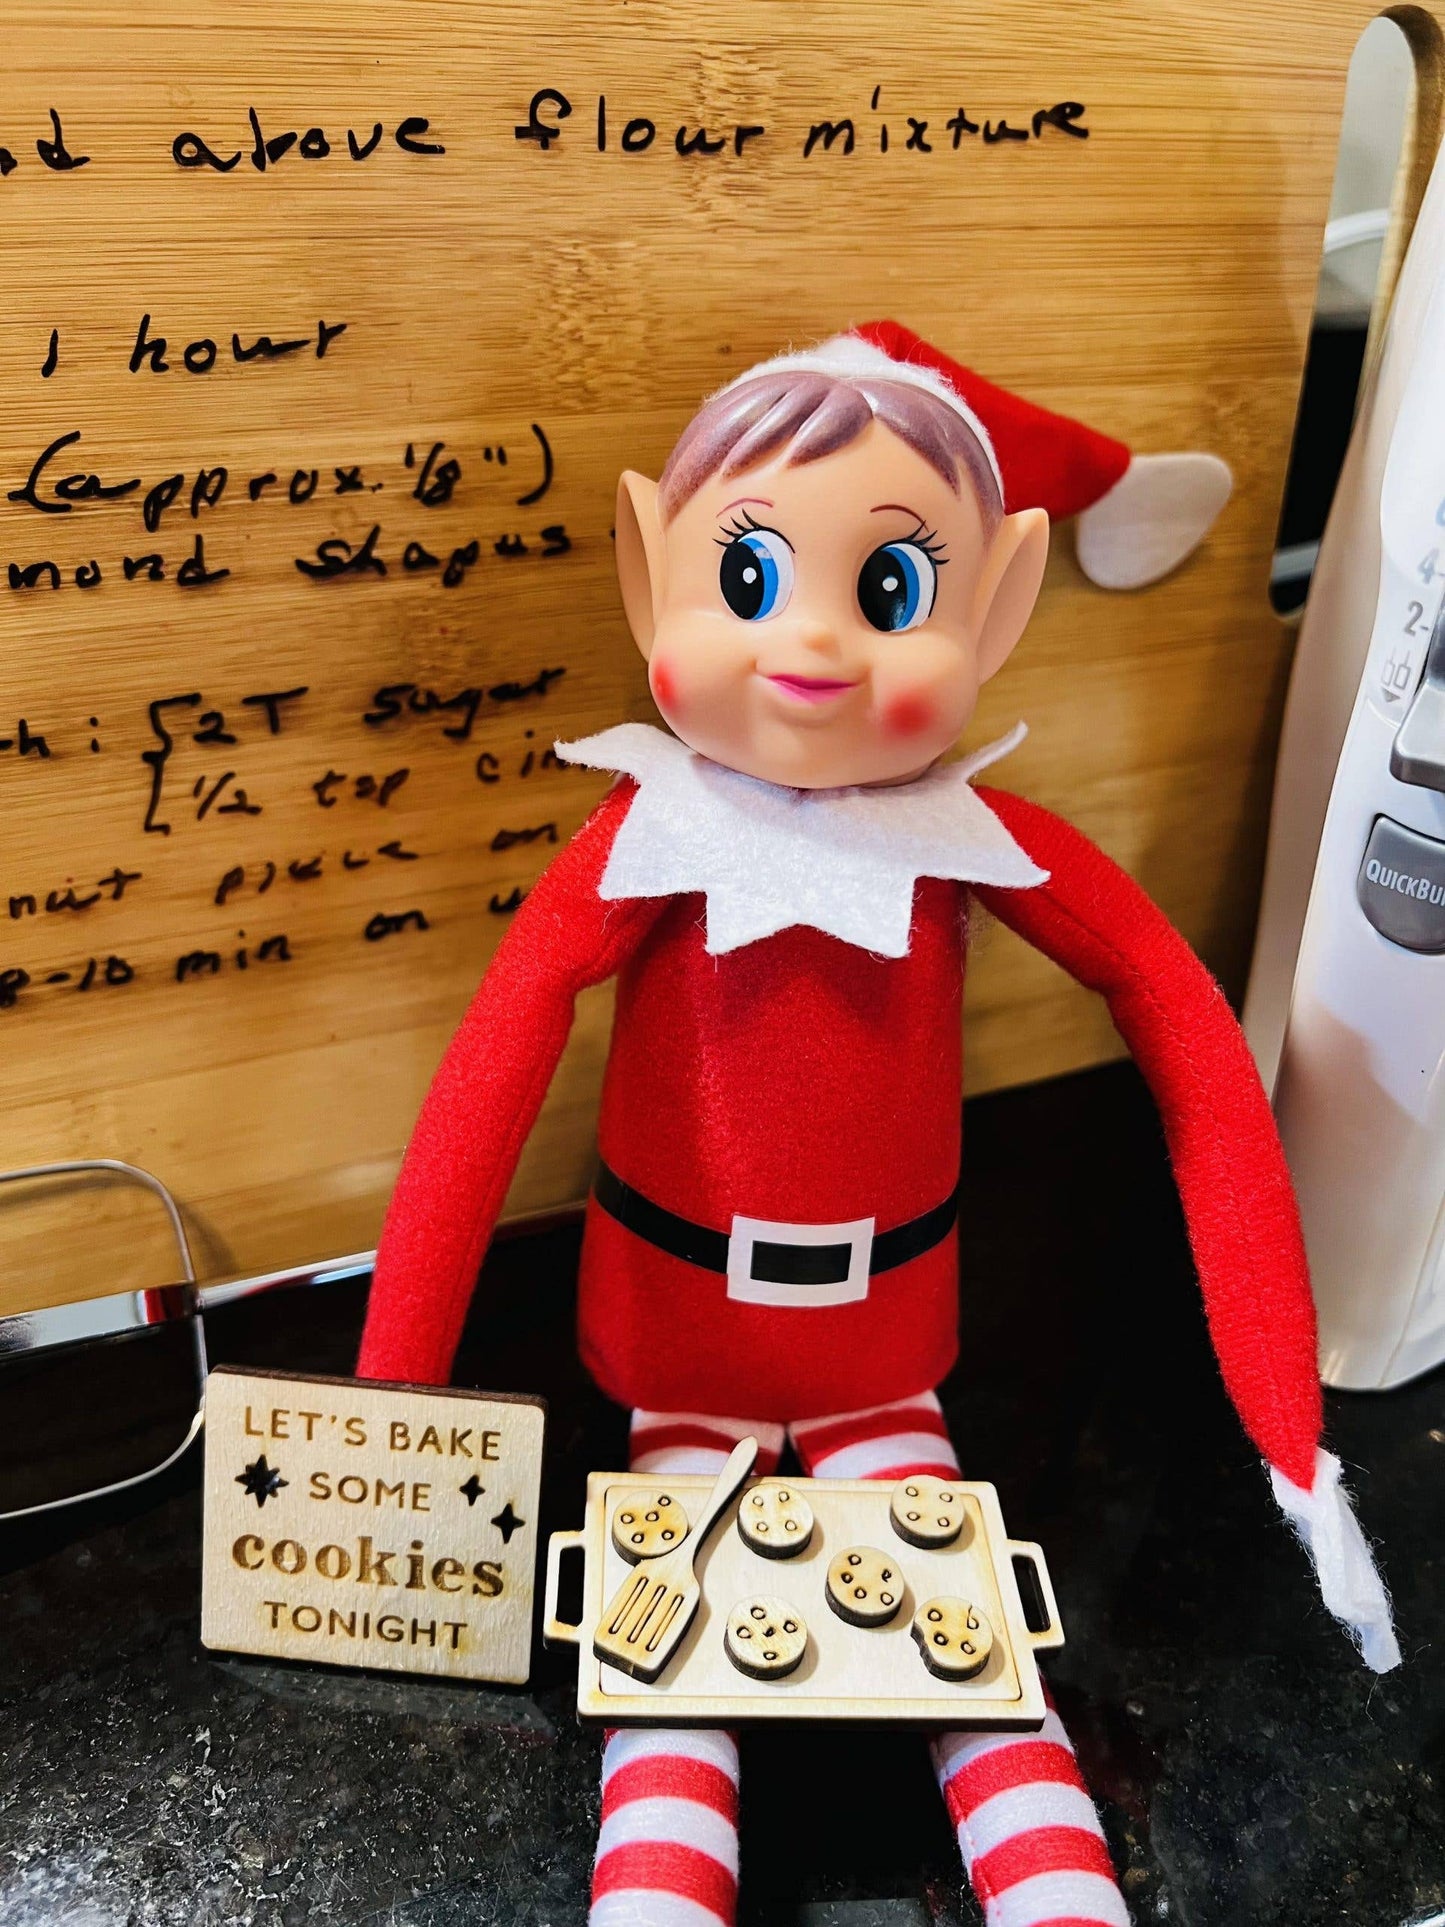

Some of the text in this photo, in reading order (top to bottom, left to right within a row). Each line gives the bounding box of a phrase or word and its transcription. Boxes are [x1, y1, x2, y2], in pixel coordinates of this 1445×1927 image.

[172, 106, 445, 172] above
[514, 88, 765, 156] flour
[803, 85, 1089, 158] mixture
[129, 313, 347, 373] hour
[8, 430, 383, 532] (approx.
[1403, 600, 1424, 637] 2
[364, 667, 566, 739] sugar
[175, 929, 291, 982] min
[365, 909, 429, 941] on
[245, 1405, 502, 1461] LET'S BAKE
[309, 1471, 432, 1512] SOME
[231, 1533, 505, 1598] cookies
[264, 1600, 468, 1650] TONIGHT
